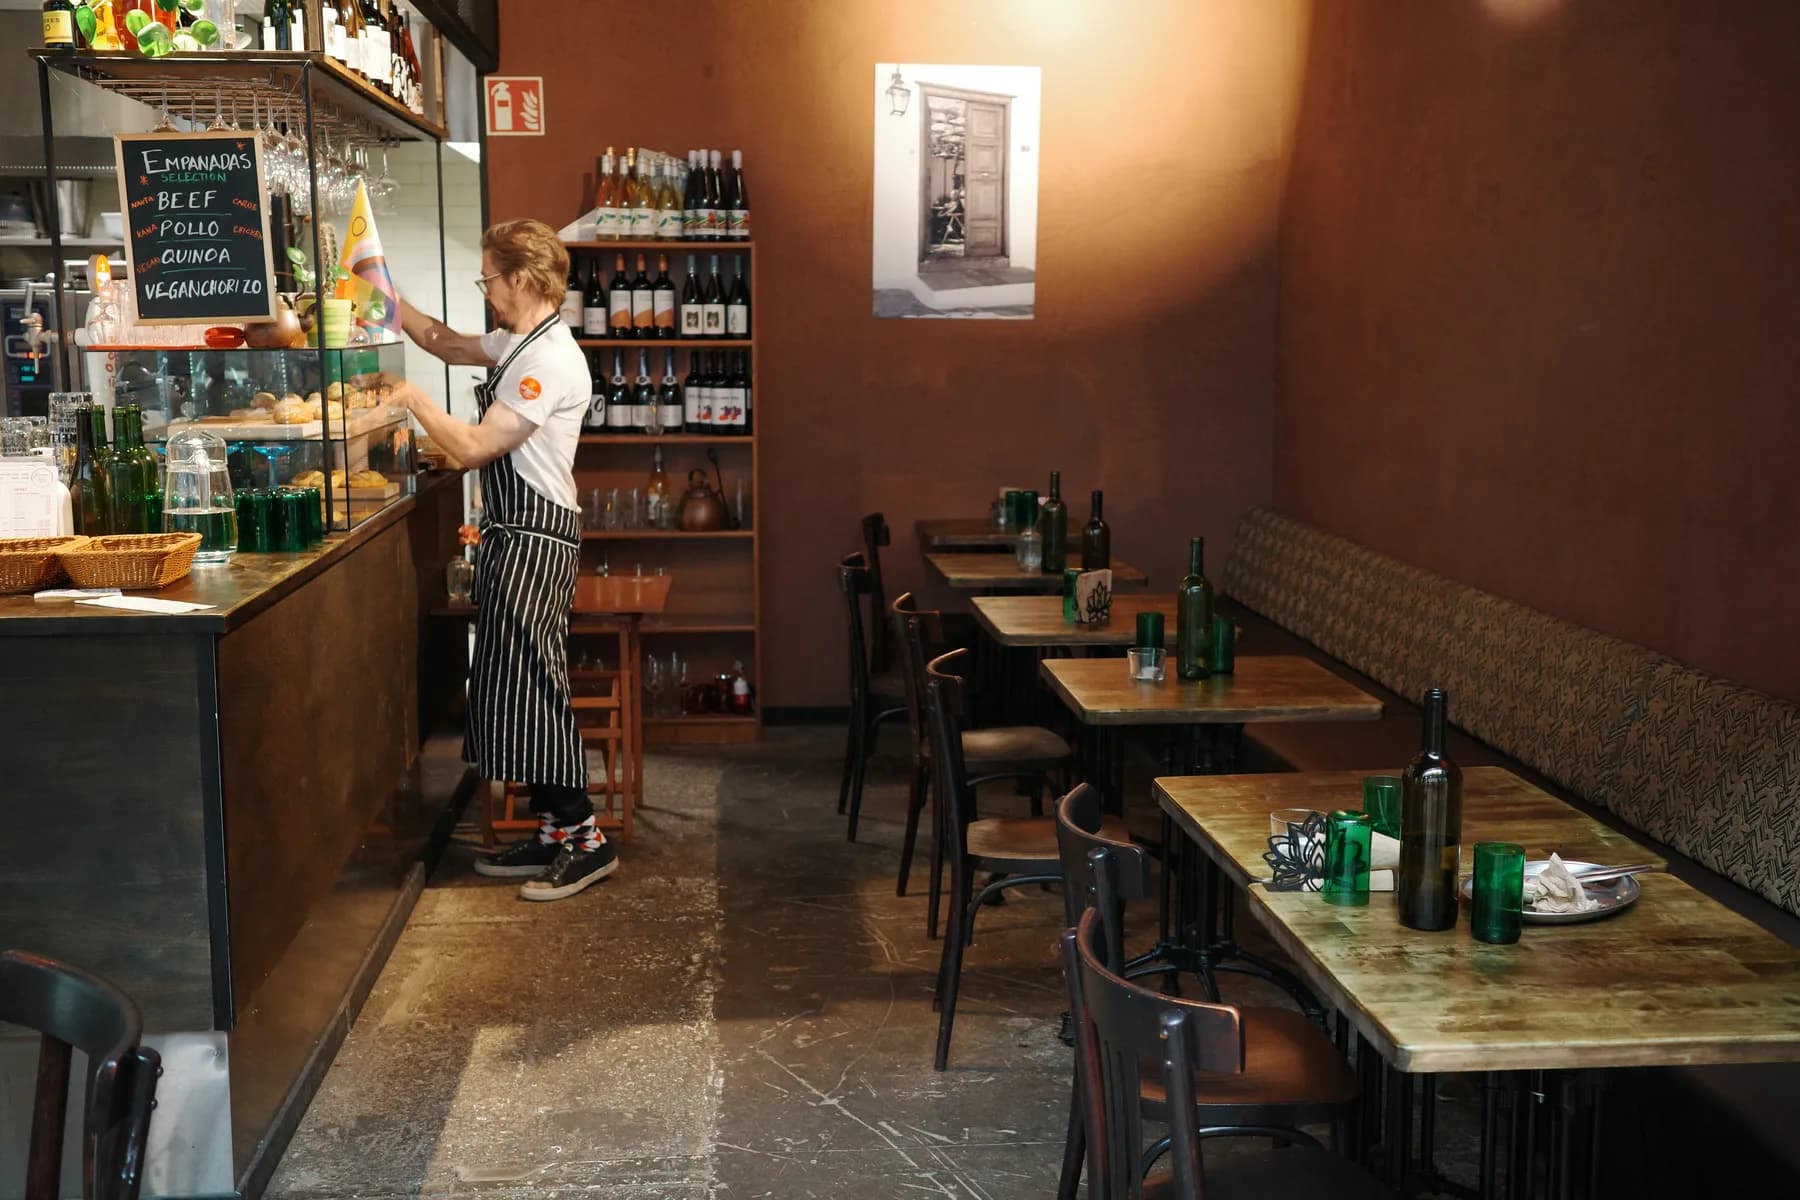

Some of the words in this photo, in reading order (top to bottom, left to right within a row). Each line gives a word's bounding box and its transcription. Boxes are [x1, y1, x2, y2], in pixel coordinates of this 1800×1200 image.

[141, 149, 252, 174] EMPANADAS
[161, 172, 227, 183] SELECTION
[157, 190, 217, 211] BEEF
[160, 219, 219, 237] POLLO
[161, 247, 231, 264] QUINOA
